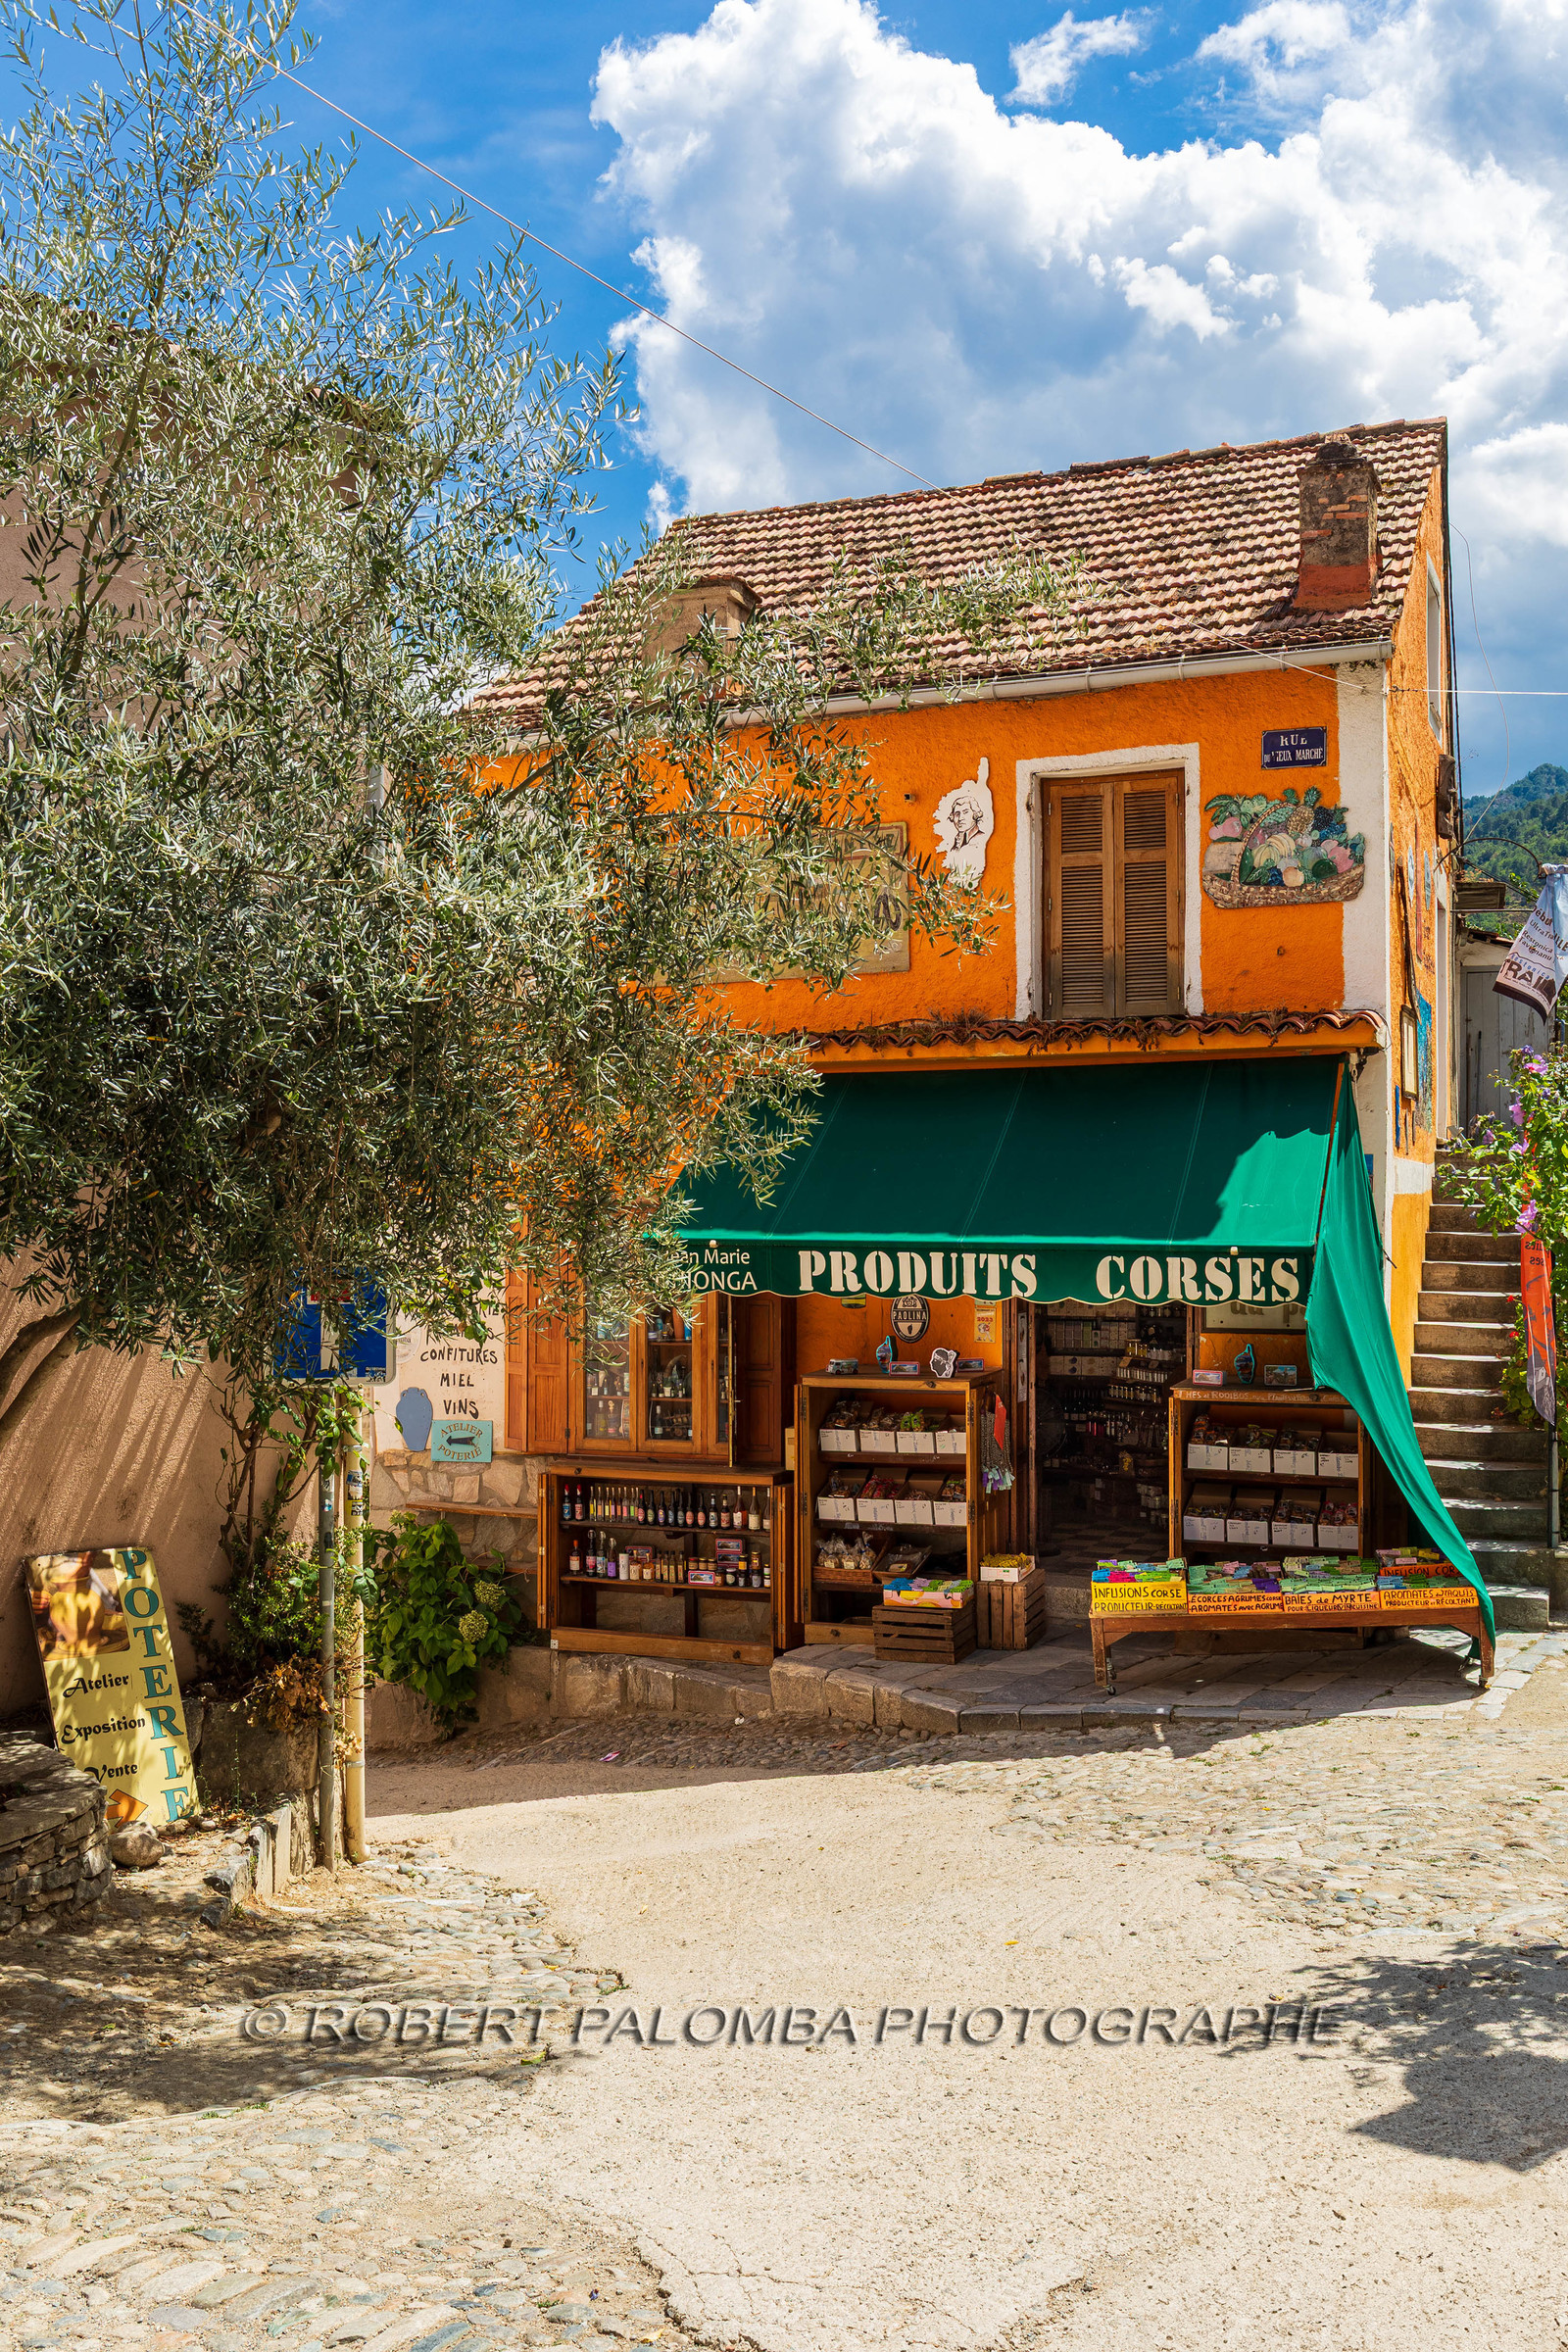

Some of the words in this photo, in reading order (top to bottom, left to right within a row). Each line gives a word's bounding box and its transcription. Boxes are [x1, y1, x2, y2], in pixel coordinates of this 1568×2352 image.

[1522, 929, 1553, 954] Restonica
[705, 1249, 750, 1264] Marie
[799, 1250, 1037, 1298] PRODUITS
[1096, 1255, 1299, 1301] CORSES
[893, 1310, 927, 1320] PAOLINA
[420, 1347, 498, 1365] CONFITURES
[439, 1373, 474, 1388] MIEL
[443, 1398, 478, 1420] VINS
[441, 1422, 483, 1439] ATELIER
[438, 1443, 482, 1461] POTERIE
[1435, 1565, 1459, 1576] COR
[1151, 1589, 1182, 1598] CORSE
[1285, 1593, 1312, 1605] BAIES
[1333, 1592, 1372, 1603] MYRTE
[1383, 1589, 1434, 1599] AROMATES
[62, 1674, 129, 1698] Atelier
[118, 1549, 195, 1823] POTERIE
[61, 1716, 146, 1745] Exposition
[84, 1762, 138, 1784] Vente
